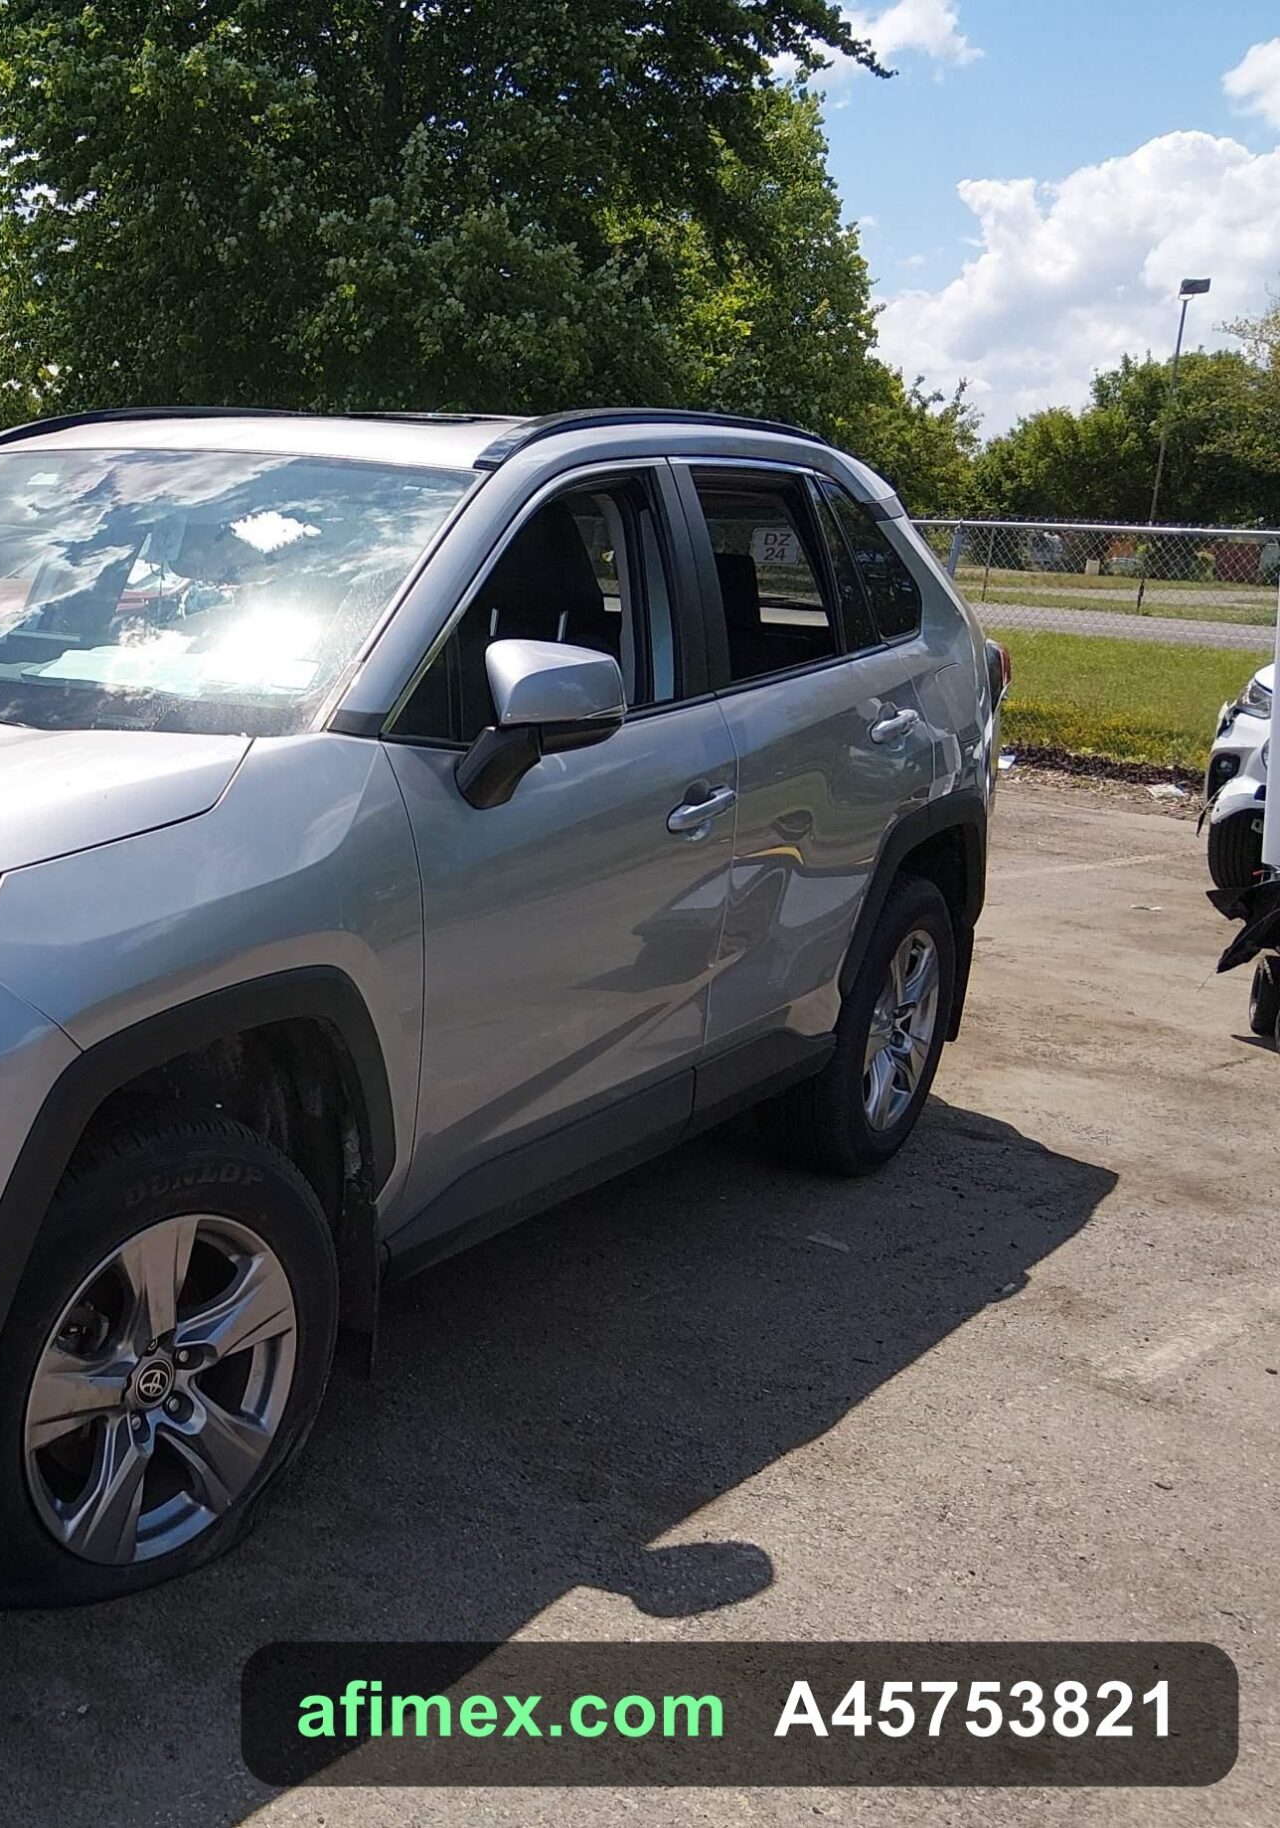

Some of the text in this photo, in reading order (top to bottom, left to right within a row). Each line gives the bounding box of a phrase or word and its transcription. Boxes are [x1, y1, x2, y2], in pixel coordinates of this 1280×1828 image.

[764, 532, 792, 546] DZ
[763, 547, 787, 561] 24
[125, 1162, 266, 1206] DUNLOP
